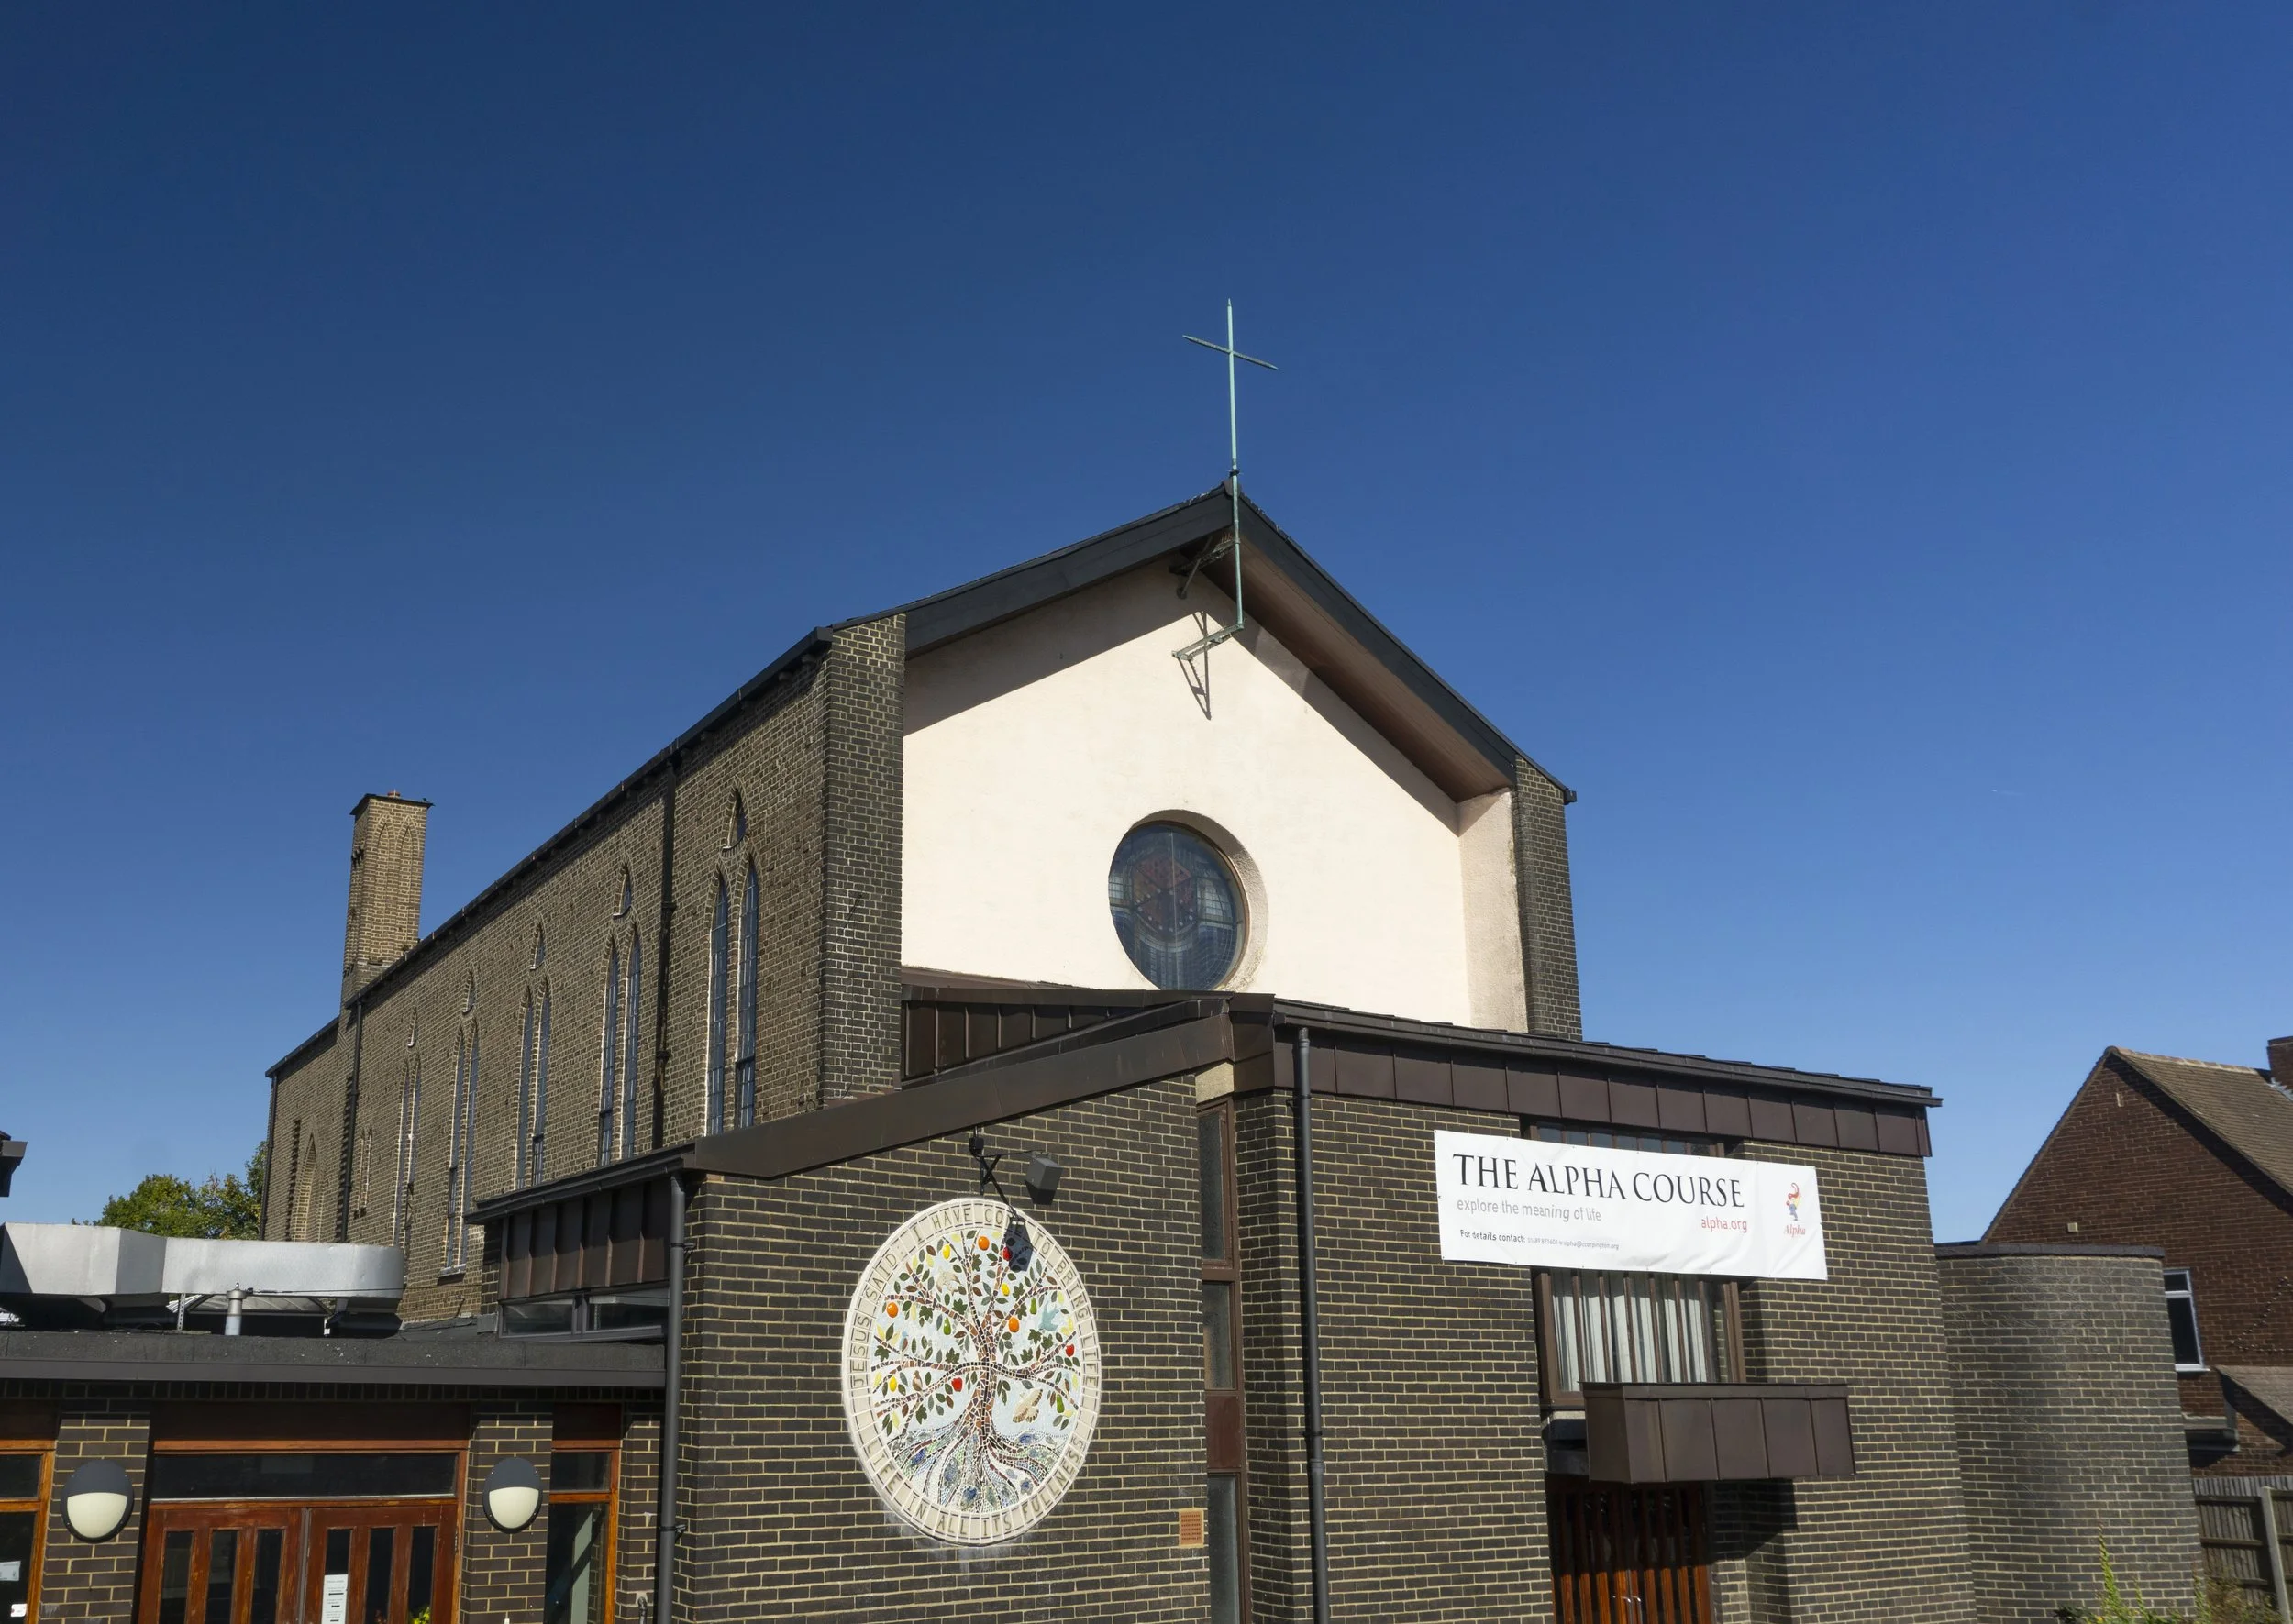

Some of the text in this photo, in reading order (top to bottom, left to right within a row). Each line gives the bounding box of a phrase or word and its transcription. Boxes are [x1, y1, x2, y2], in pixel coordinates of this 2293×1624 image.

[1453, 1154, 1745, 1208] THE ALPHA COURSE
[1457, 1198, 1601, 1222] explore the meaning of life
[1460, 1229, 1471, 1238] For
[1472, 1231, 1497, 1241] details
[1499, 1233, 1525, 1243] contact:
[1701, 1216, 1747, 1233] alpha.org
[1784, 1224, 1806, 1237] Alpha
[853, 1315, 870, 1386] JESUS
[931, 1207, 971, 1231] HAVE
[1034, 1232, 1051, 1254] TO
[1056, 1259, 1089, 1319] BRING
[1083, 1333, 1098, 1387] LIFE
[868, 1436, 1084, 1537] LIFE IN ALL ITS FULLNESS
